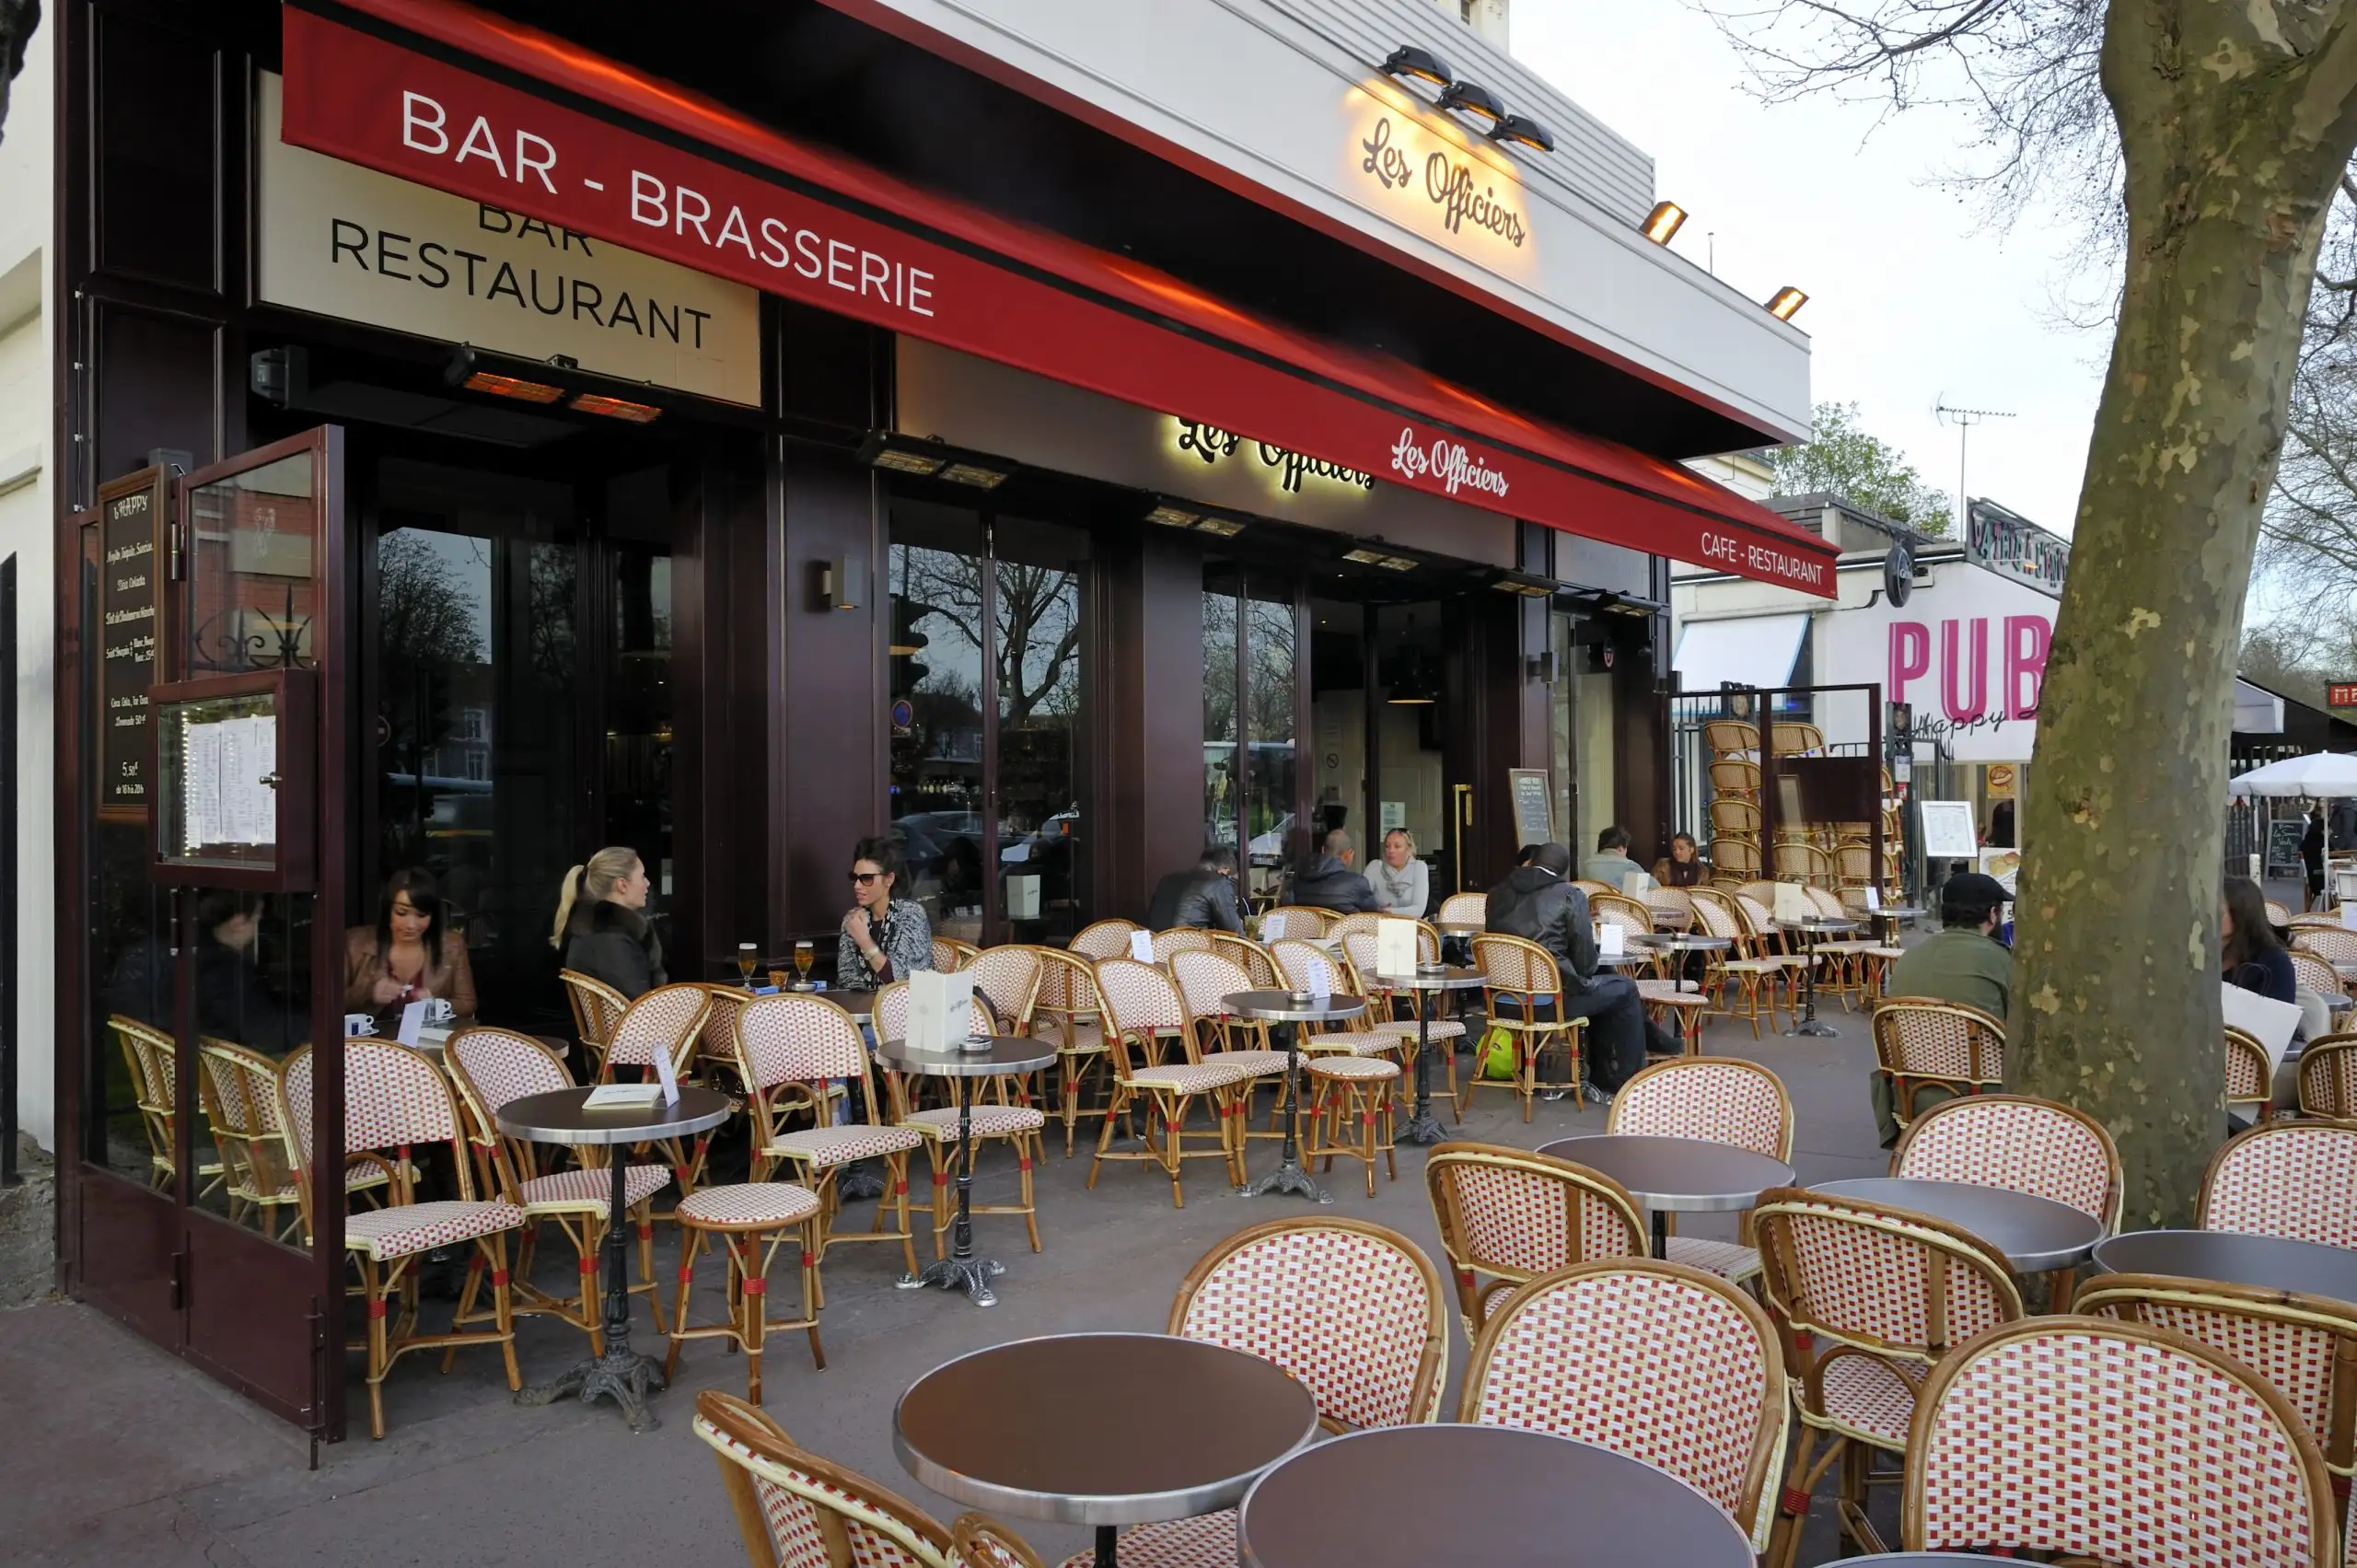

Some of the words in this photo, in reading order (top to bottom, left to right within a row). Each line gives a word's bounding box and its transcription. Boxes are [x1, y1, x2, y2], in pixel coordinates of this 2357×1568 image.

[401, 90, 558, 194] BAR
[631, 169, 935, 317] BRASSERIE
[1363, 117, 1412, 190] Les
[1425, 151, 1526, 248] Officiers
[331, 218, 711, 349] RESTAURANT
[1391, 426, 1429, 479] Les
[1431, 439, 1509, 497] Officiers
[1701, 531, 1737, 563] CAFE
[1747, 544, 1824, 586] RESTAURANT
[1888, 614, 2052, 723] PUB
[1911, 711, 2008, 739] Happy
